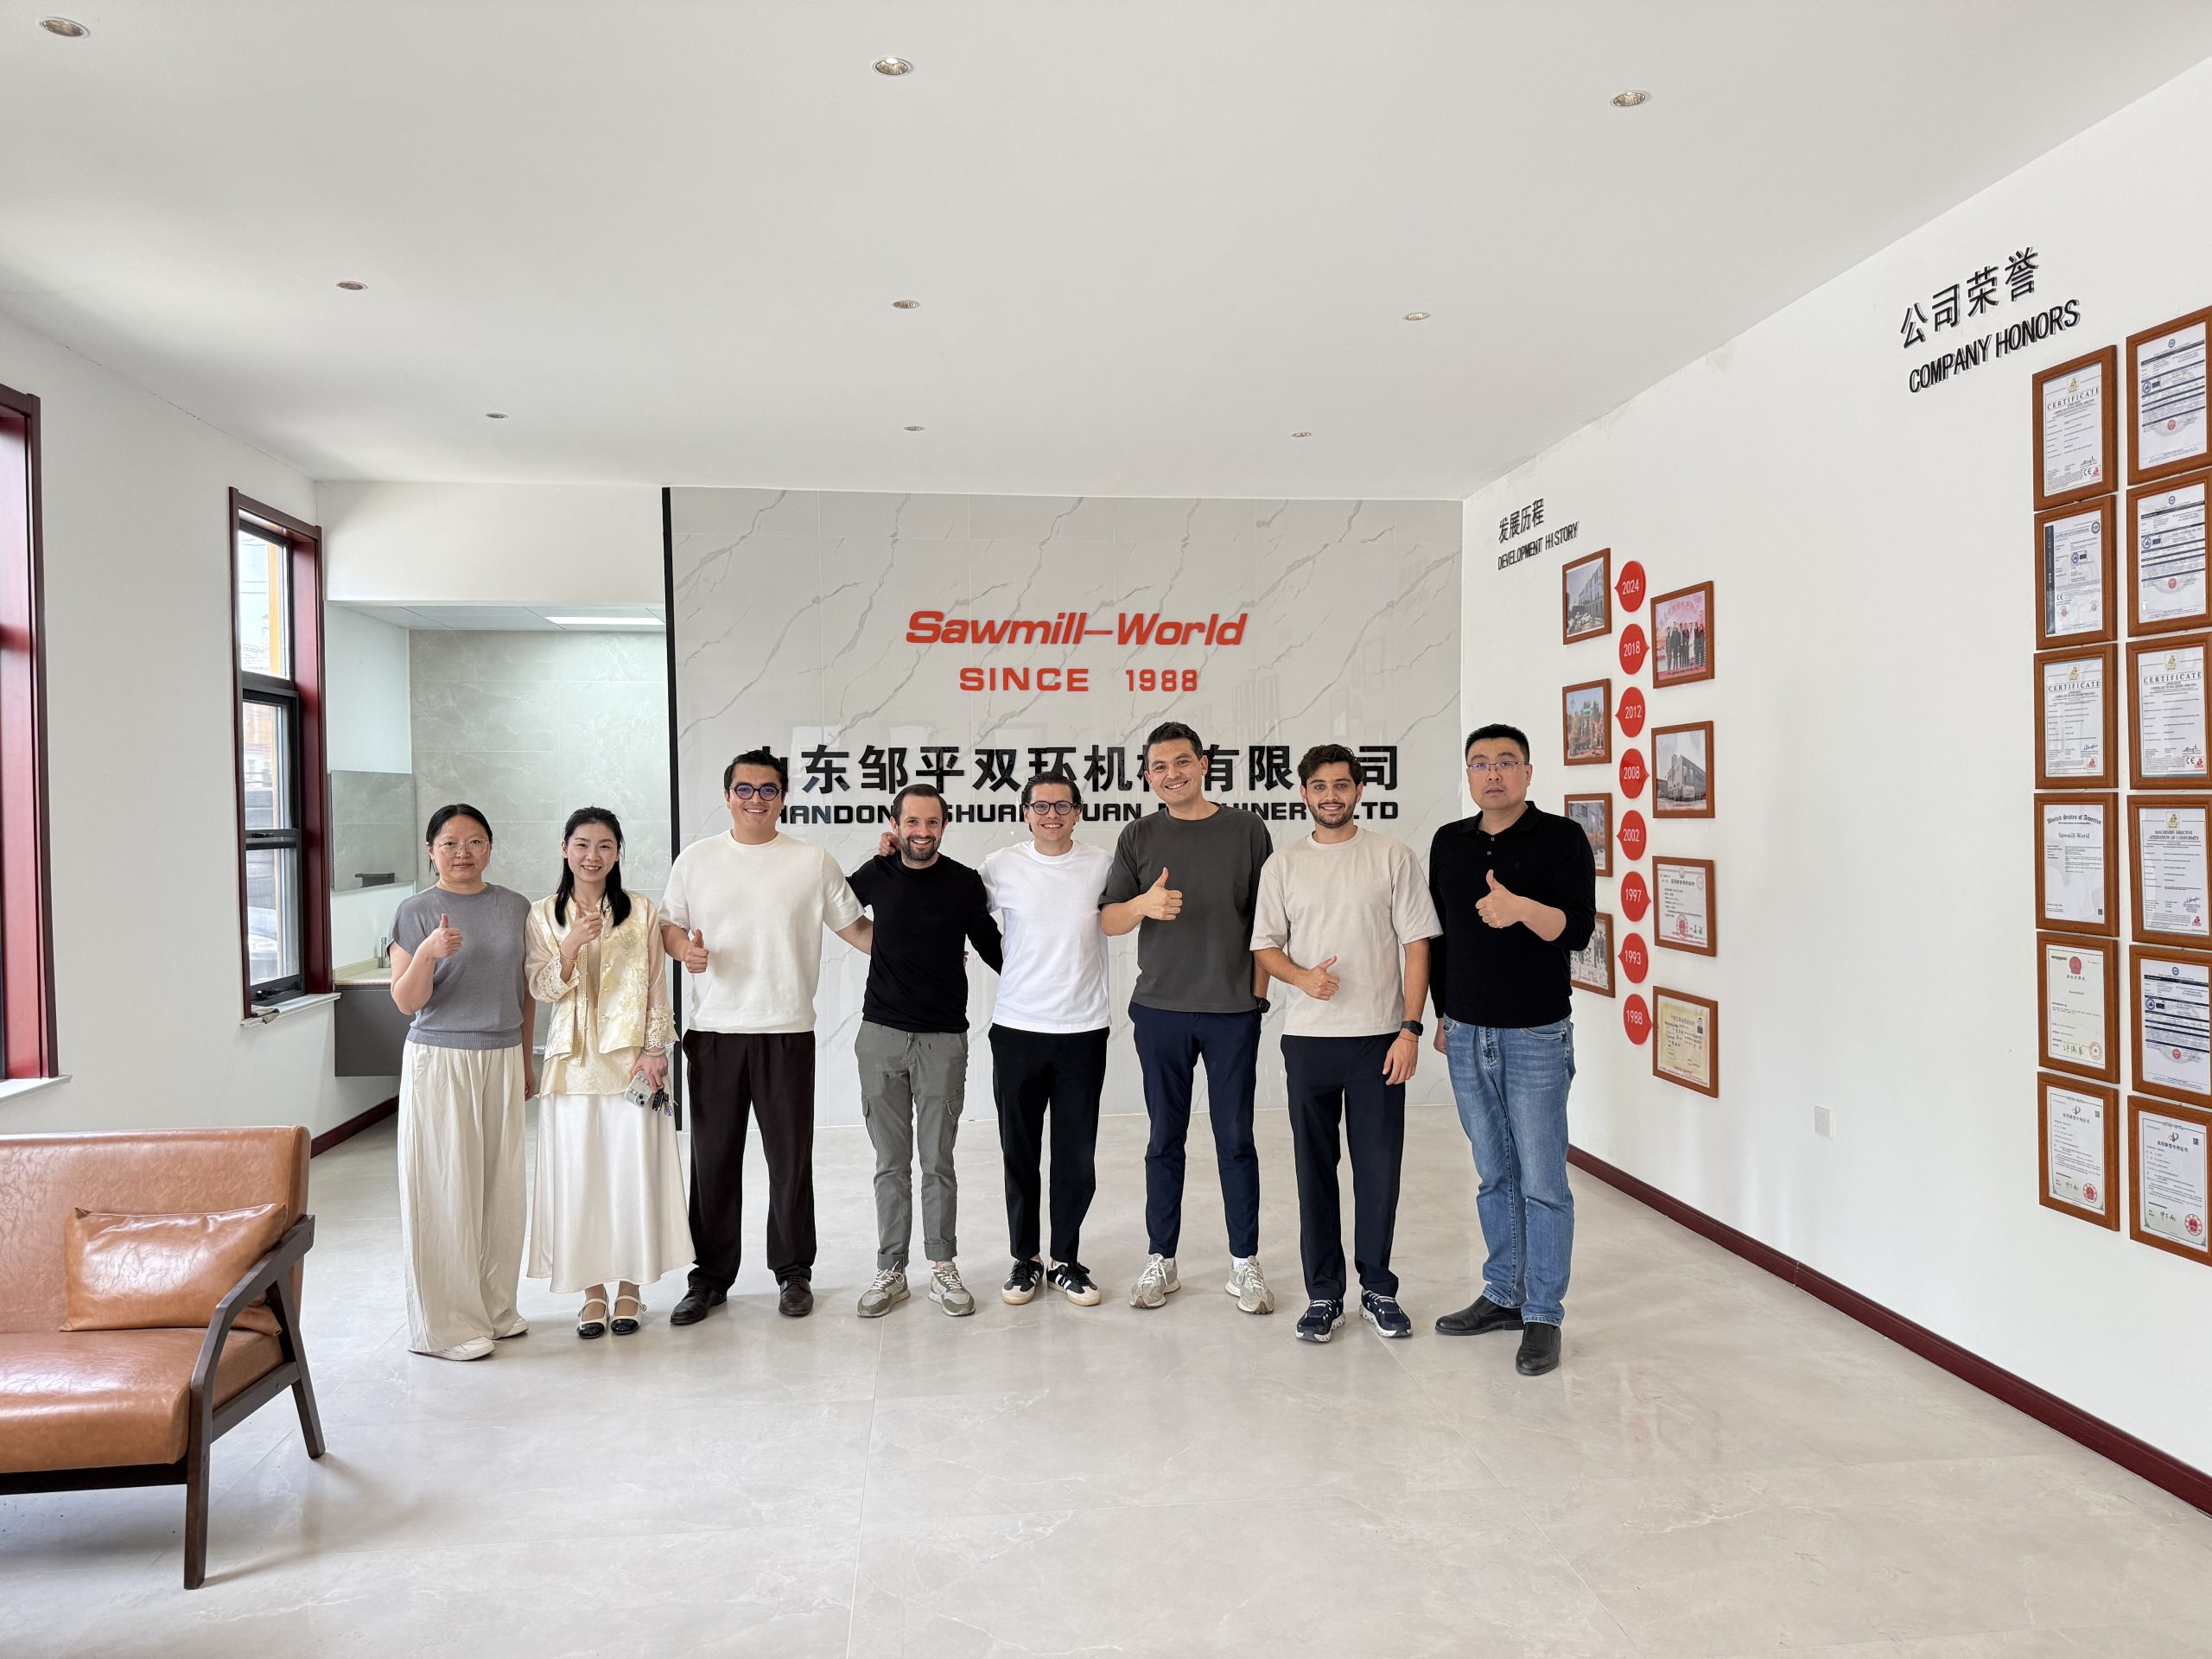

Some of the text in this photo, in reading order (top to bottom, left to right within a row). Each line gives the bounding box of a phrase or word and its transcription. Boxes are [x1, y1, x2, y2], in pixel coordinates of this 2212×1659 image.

[1900, 247, 2039, 349] 公司荣誉
[1909, 299, 2081, 393] COMPANY HONORS
[2047, 387, 2100, 410] CERTIFICATE
[1498, 498, 1544, 544] 发展历程
[1497, 537, 1544, 570] DEVELOPMENT
[1622, 578, 1639, 595] 2024
[1624, 640, 1641, 658] 2018
[959, 667, 1198, 692] SINCE 1988
[2143, 671, 2202, 683] CERTIFICATE
[2048, 681, 2101, 691] CERTIFICATE
[1624, 704, 1642, 719] 2012
[761, 744, 1398, 797] 东邹平双环机有限司
[1624, 766, 1640, 779] 2008
[779, 804, 894, 823] ANDON
[2083, 814, 2101, 825] America
[1624, 829, 1640, 842] 2002
[1625, 888, 1642, 903] 1997
[1624, 950, 1642, 965] 1993
[1626, 1009, 1643, 1025] 1988
